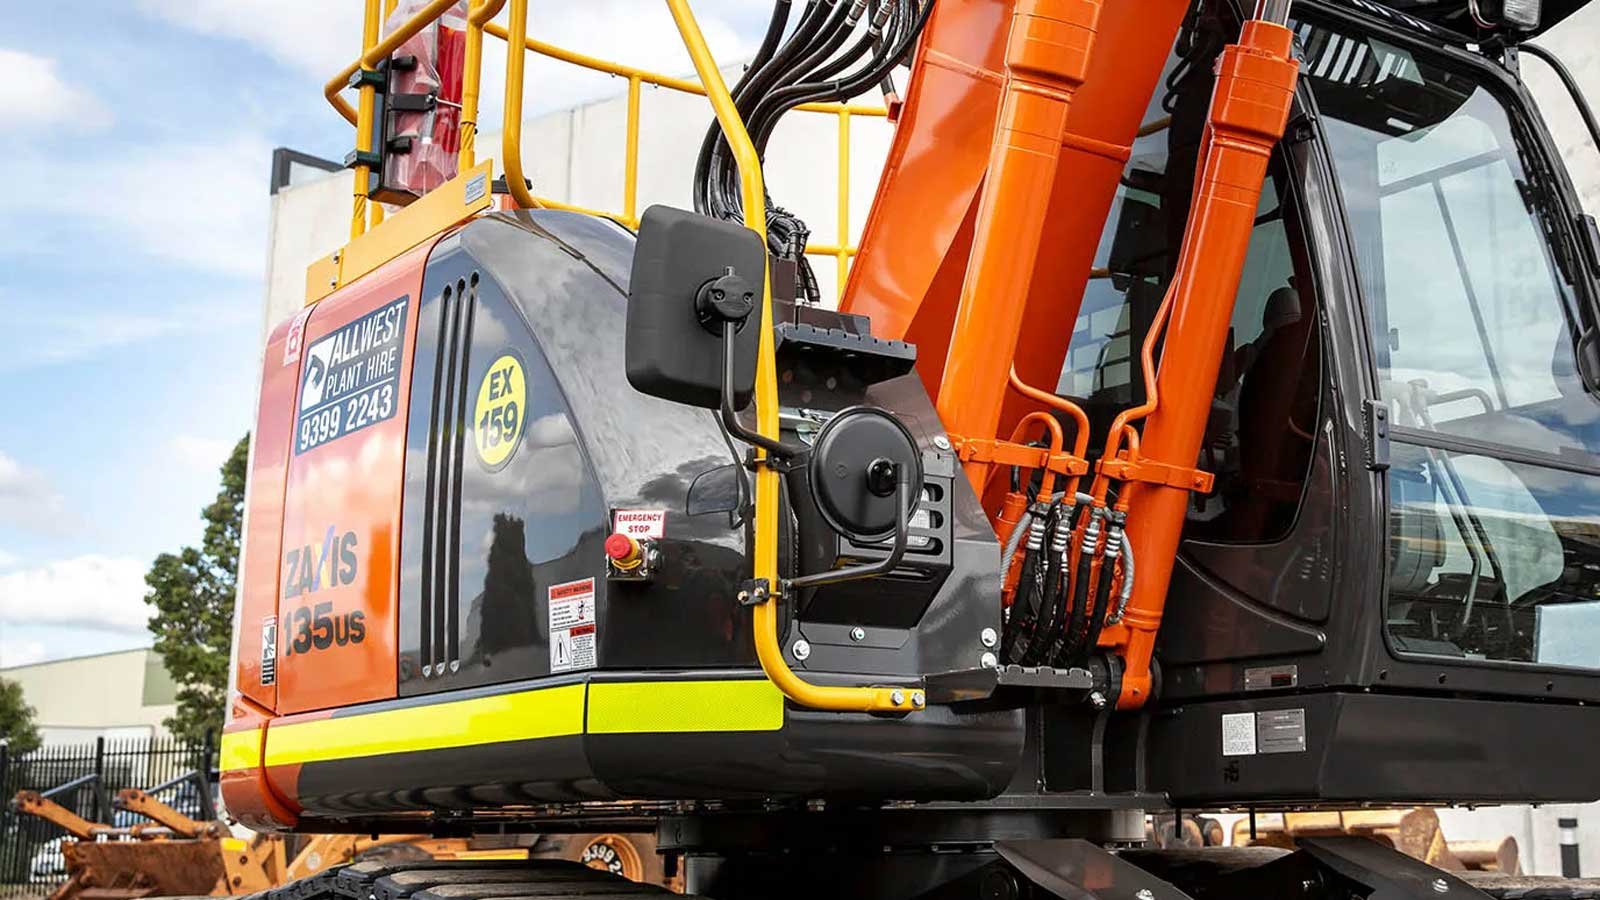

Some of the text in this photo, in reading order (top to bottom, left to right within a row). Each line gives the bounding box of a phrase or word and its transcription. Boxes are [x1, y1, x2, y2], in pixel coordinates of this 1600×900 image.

[330, 301, 407, 368] ALLWEST
[325, 347, 397, 400] PLANT HIRE
[489, 365, 515, 401] EX
[300, 384, 393, 450] 9399 2243
[480, 401, 518, 449] 159
[618, 513, 662, 522] EMERGENCY
[628, 525, 650, 533] STOP
[284, 525, 358, 599] ZAXIS
[583, 845, 623, 876] 9399 2
